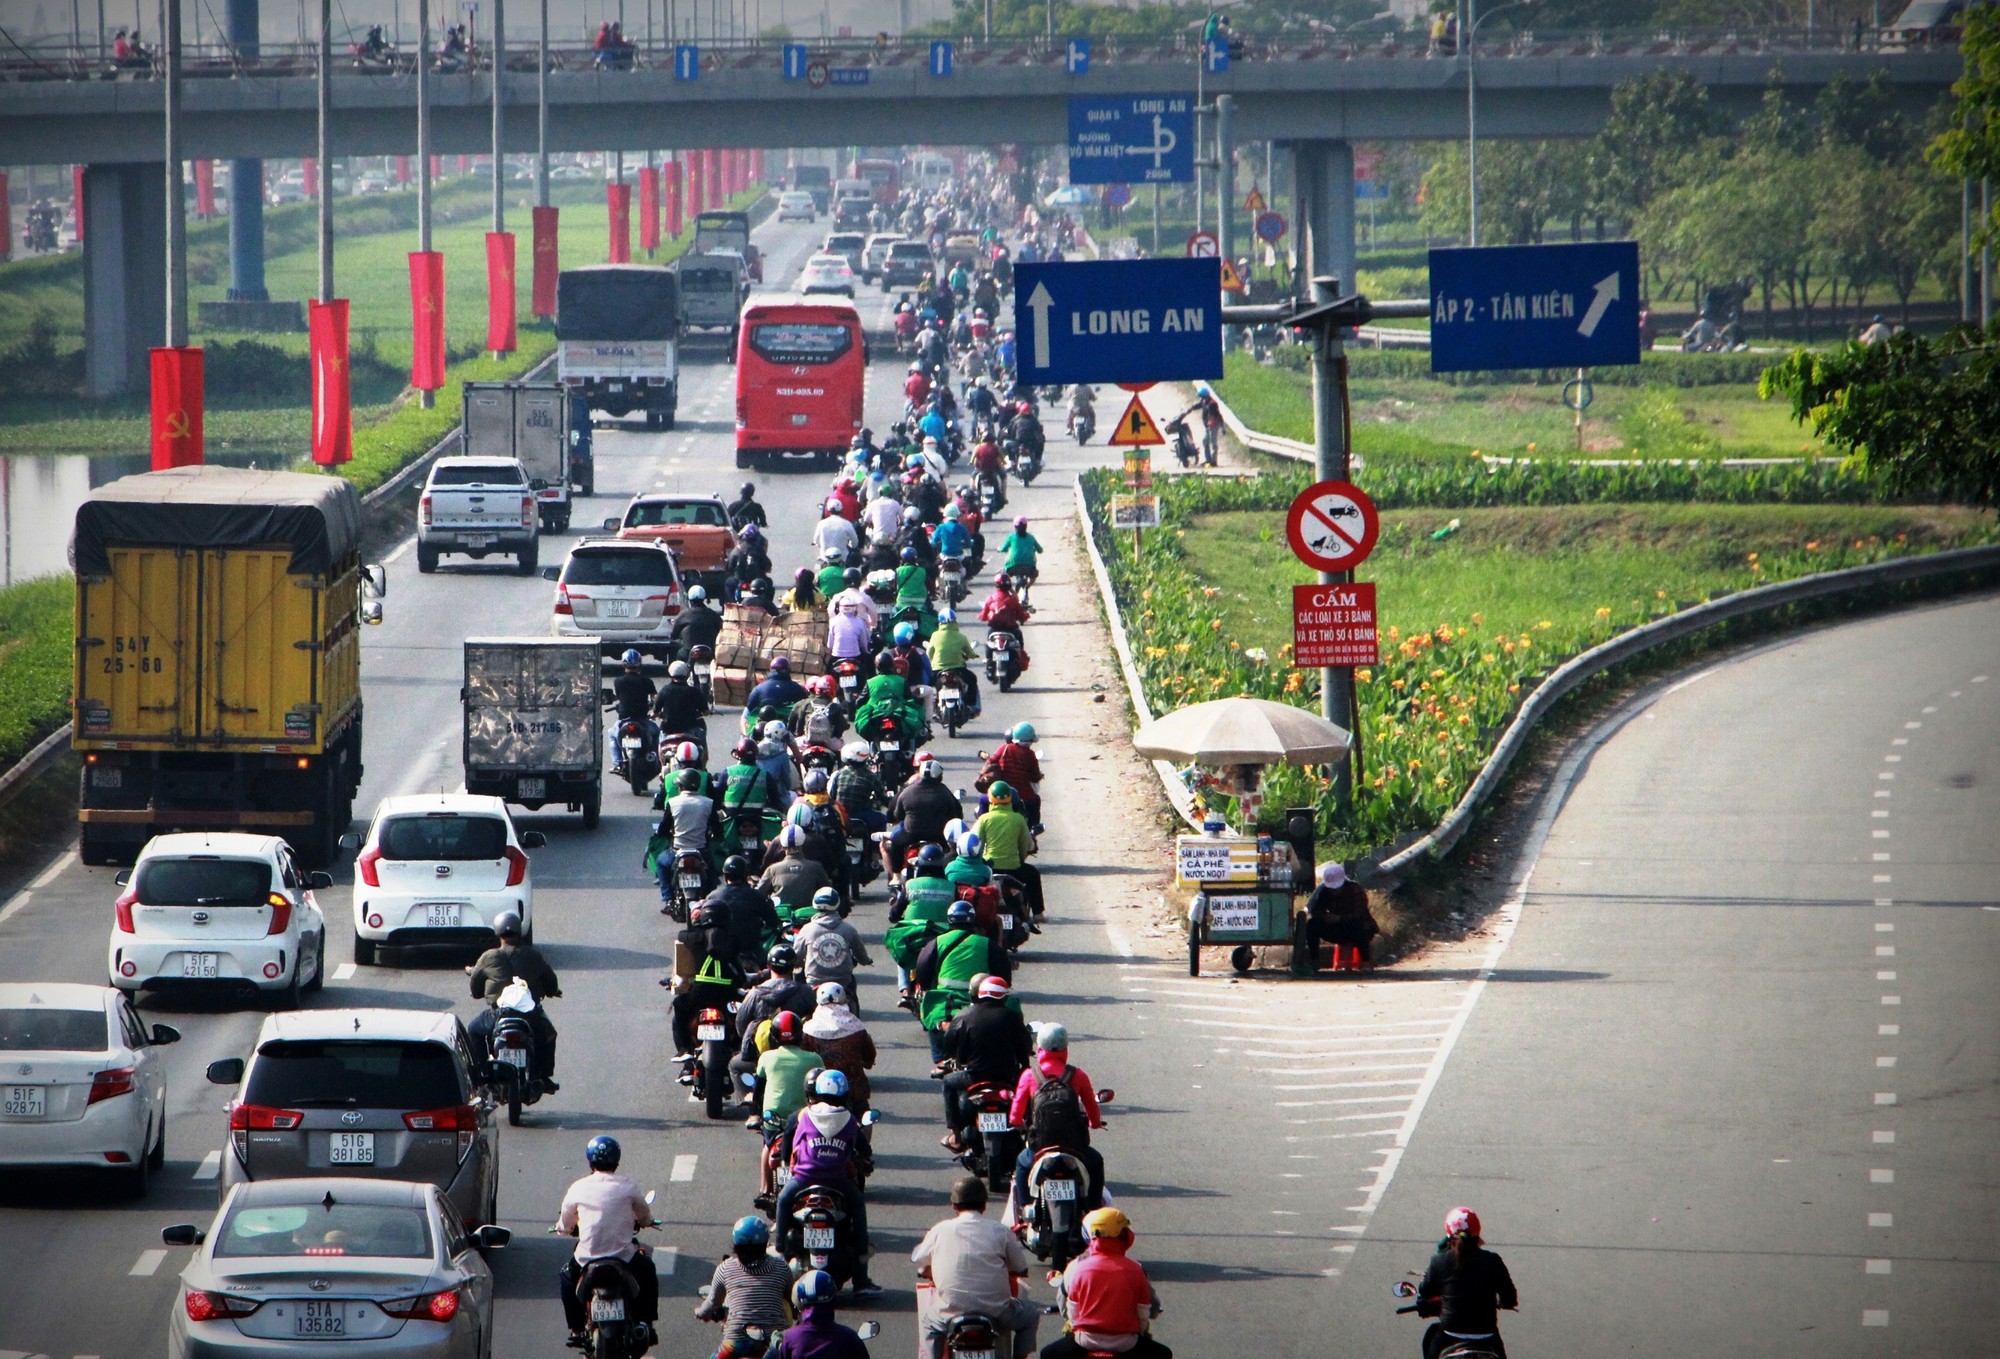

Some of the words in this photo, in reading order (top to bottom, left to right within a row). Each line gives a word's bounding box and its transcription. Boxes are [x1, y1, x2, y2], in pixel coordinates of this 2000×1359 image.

[1133, 99, 1164, 114] LONG
[1169, 98, 1186, 112] AN
[1435, 290, 1458, 323] ẤP
[1464, 297, 1474, 322] 2
[1491, 292, 1526, 320] TÂN
[1532, 289, 1574, 319] KIÊN
[1072, 309, 1149, 335] LONG
[1162, 308, 1204, 333] AN
[1312, 587, 1357, 607] CẤM
[1299, 609, 1313, 624] CÁC
[1315, 611, 1331, 625] LOẠI
[1333, 610, 1342, 622] XE
[1344, 611, 1349, 622] 3
[1351, 607, 1371, 622] BÁNH
[1296, 627, 1306, 642] VÀ
[1308, 630, 1317, 642] XE
[1336, 627, 1346, 641] SƠ
[1347, 629, 1352, 640] 4
[1354, 625, 1375, 640] BÁNH
[115, 636, 149, 652] 54Y
[1204, 859, 1224, 868] PHÊ
[1185, 869, 1205, 878] NƯỚC
[435, 905, 451, 916] 51F
[428, 916, 459, 926] 683.18
[191, 955, 208, 967] 51F
[13, 1088, 35, 1100] 51F
[5, 1101, 42, 1114] 928.71
[341, 1134, 364, 1148] 51G
[332, 1148, 373, 1162] 381.85
[306, 1302, 333, 1318] 51A
[298, 1317, 342, 1334] 135.82
